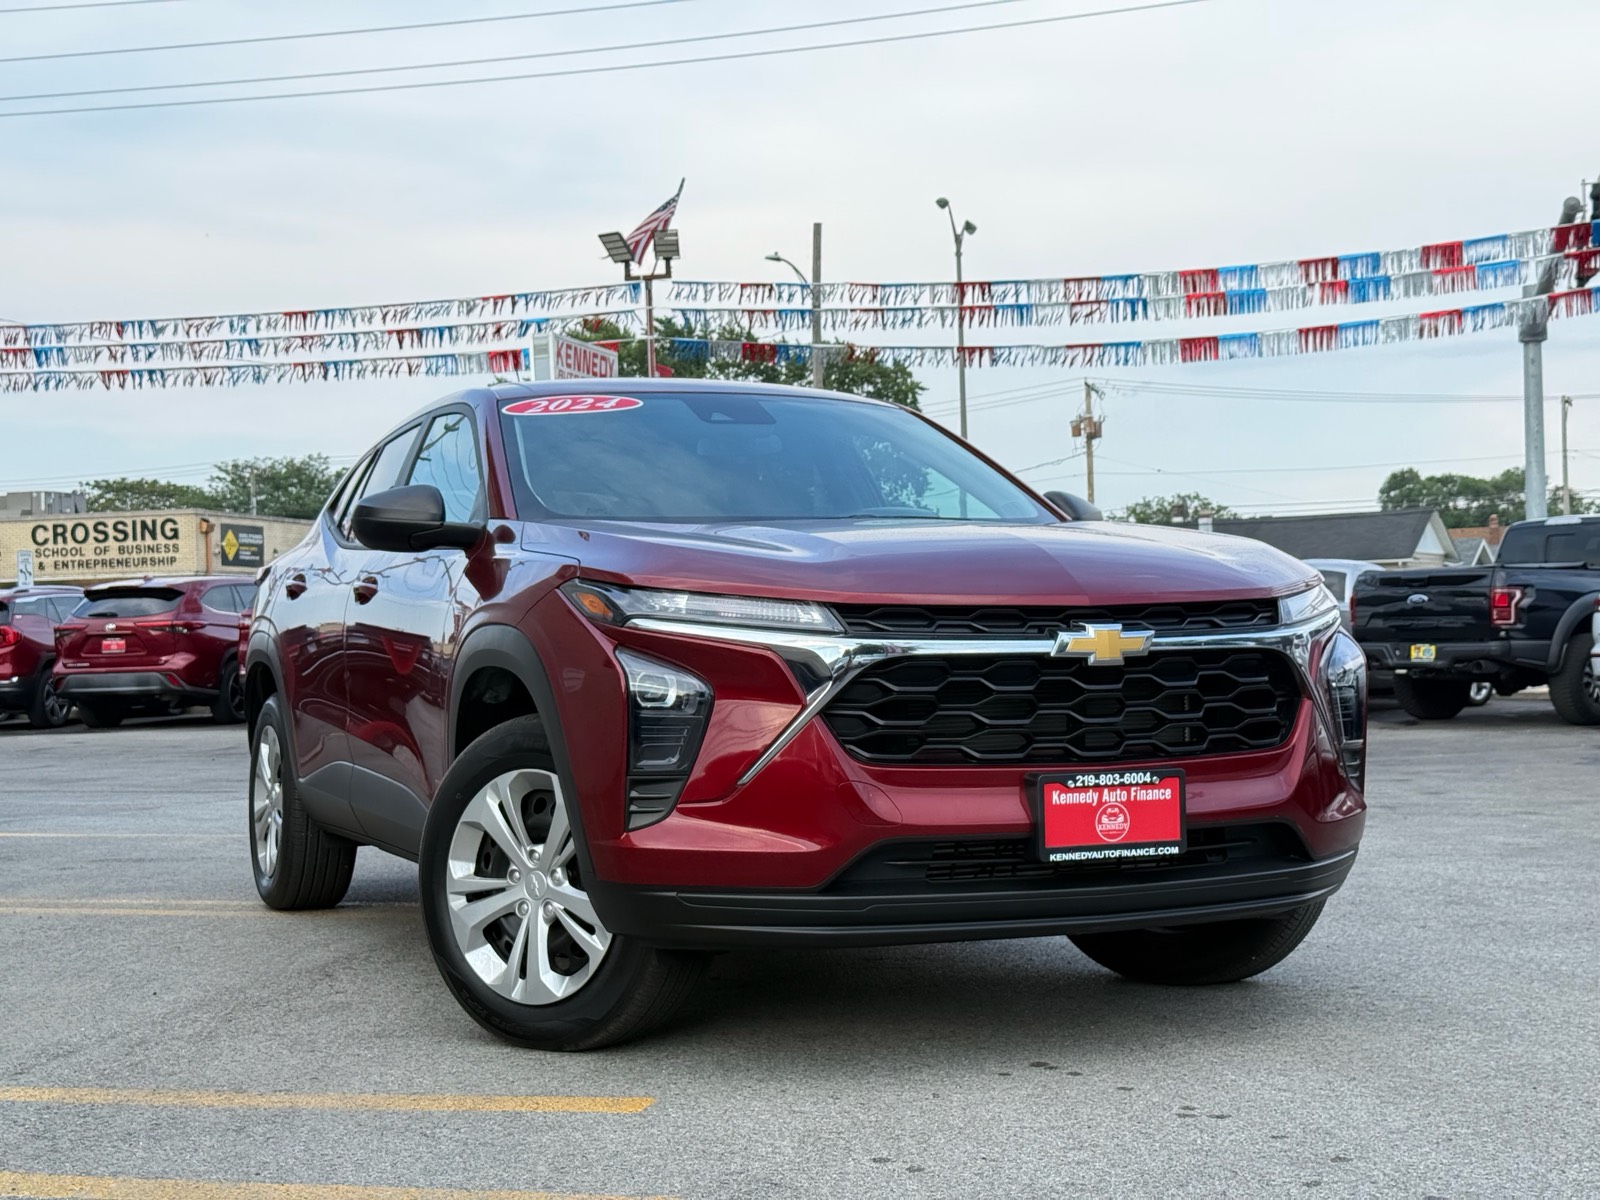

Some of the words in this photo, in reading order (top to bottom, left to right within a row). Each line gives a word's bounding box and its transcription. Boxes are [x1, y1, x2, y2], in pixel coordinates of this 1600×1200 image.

[556, 339, 615, 378] KENNEDY
[524, 397, 619, 413] 2024
[31, 518, 180, 546] CROSSING
[35, 547, 85, 558] SCHOOL
[94, 545, 110, 556] OF
[118, 543, 180, 555] BUSINESS
[38, 562, 45, 571] &
[54, 556, 177, 570] ENTREPRENEURSHIP
[1075, 772, 1151, 787] 219-803-6004
[1052, 789, 1099, 807] Kennedy
[1102, 788, 1127, 802] Auto
[1130, 787, 1171, 801] Finance
[1097, 822, 1129, 831] KENNEDY
[1049, 846, 1179, 862] KENNEDYAUTOFINANCE.COM
